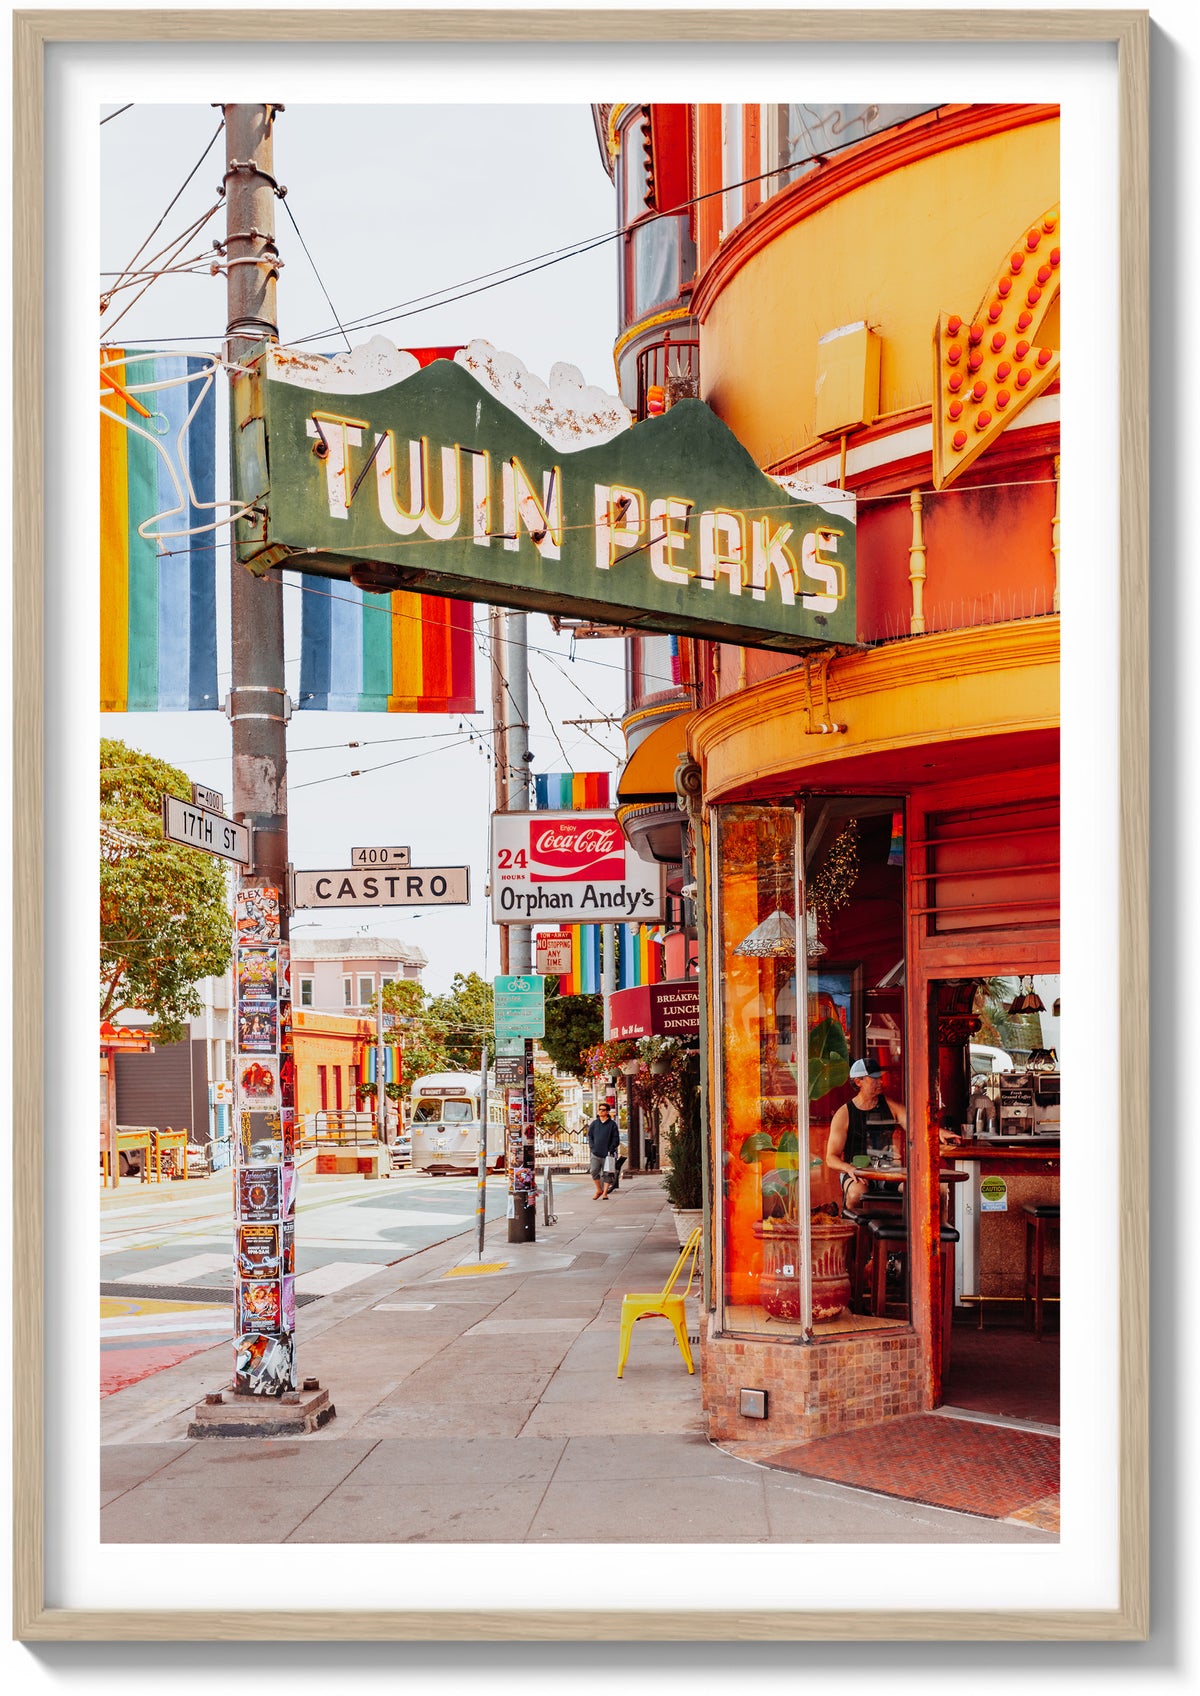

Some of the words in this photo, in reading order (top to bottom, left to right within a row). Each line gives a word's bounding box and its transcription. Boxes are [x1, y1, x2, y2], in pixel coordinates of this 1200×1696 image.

[305, 411, 564, 561] TWIN
[594, 483, 847, 615] PEAKS
[205, 791, 220, 810] 4000
[183, 811, 213, 844] 17TH
[223, 827, 237, 851] ST
[560, 824, 576, 832] Enjoy
[536, 829, 617, 853] Coca-Cola
[358, 849, 389, 863] 400
[497, 848, 529, 869] 24
[237, 889, 261, 902] FLEX
[315, 875, 448, 900] CASTRO
[501, 886, 574, 917] Orphan
[580, 885, 655, 916] Andy's
[537, 939, 547, 948] NO
[548, 940, 570, 948] STOPPING
[663, 1006, 699, 1014] LUNCH
[664, 1018, 699, 1028] DINNE
